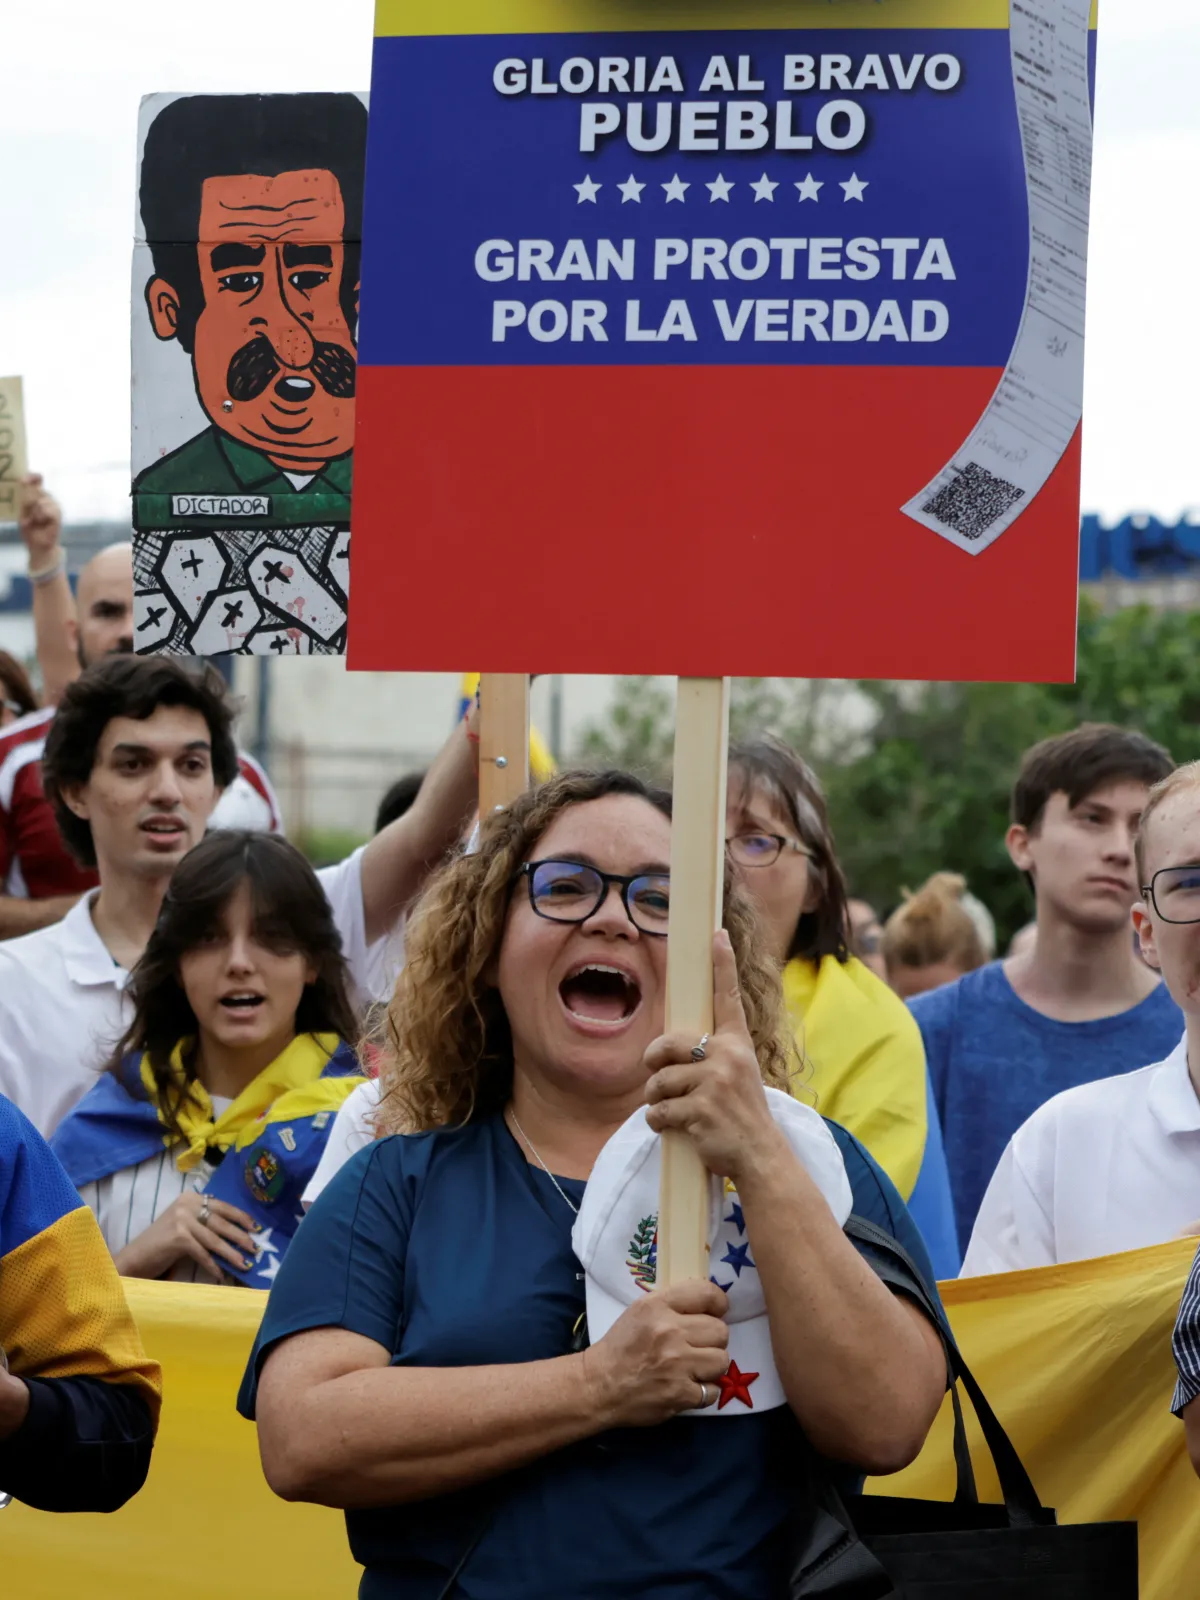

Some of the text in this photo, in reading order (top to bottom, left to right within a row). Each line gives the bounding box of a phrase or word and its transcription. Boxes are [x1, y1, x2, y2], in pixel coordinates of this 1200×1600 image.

[492, 53, 961, 95] GLORIA AL BRAVO
[579, 99, 866, 152] PUEBLO
[474, 237, 957, 282] GRAN PROTESTA
[492, 299, 949, 343] POR LA VERDAD
[176, 497, 266, 515] DICTADOR
